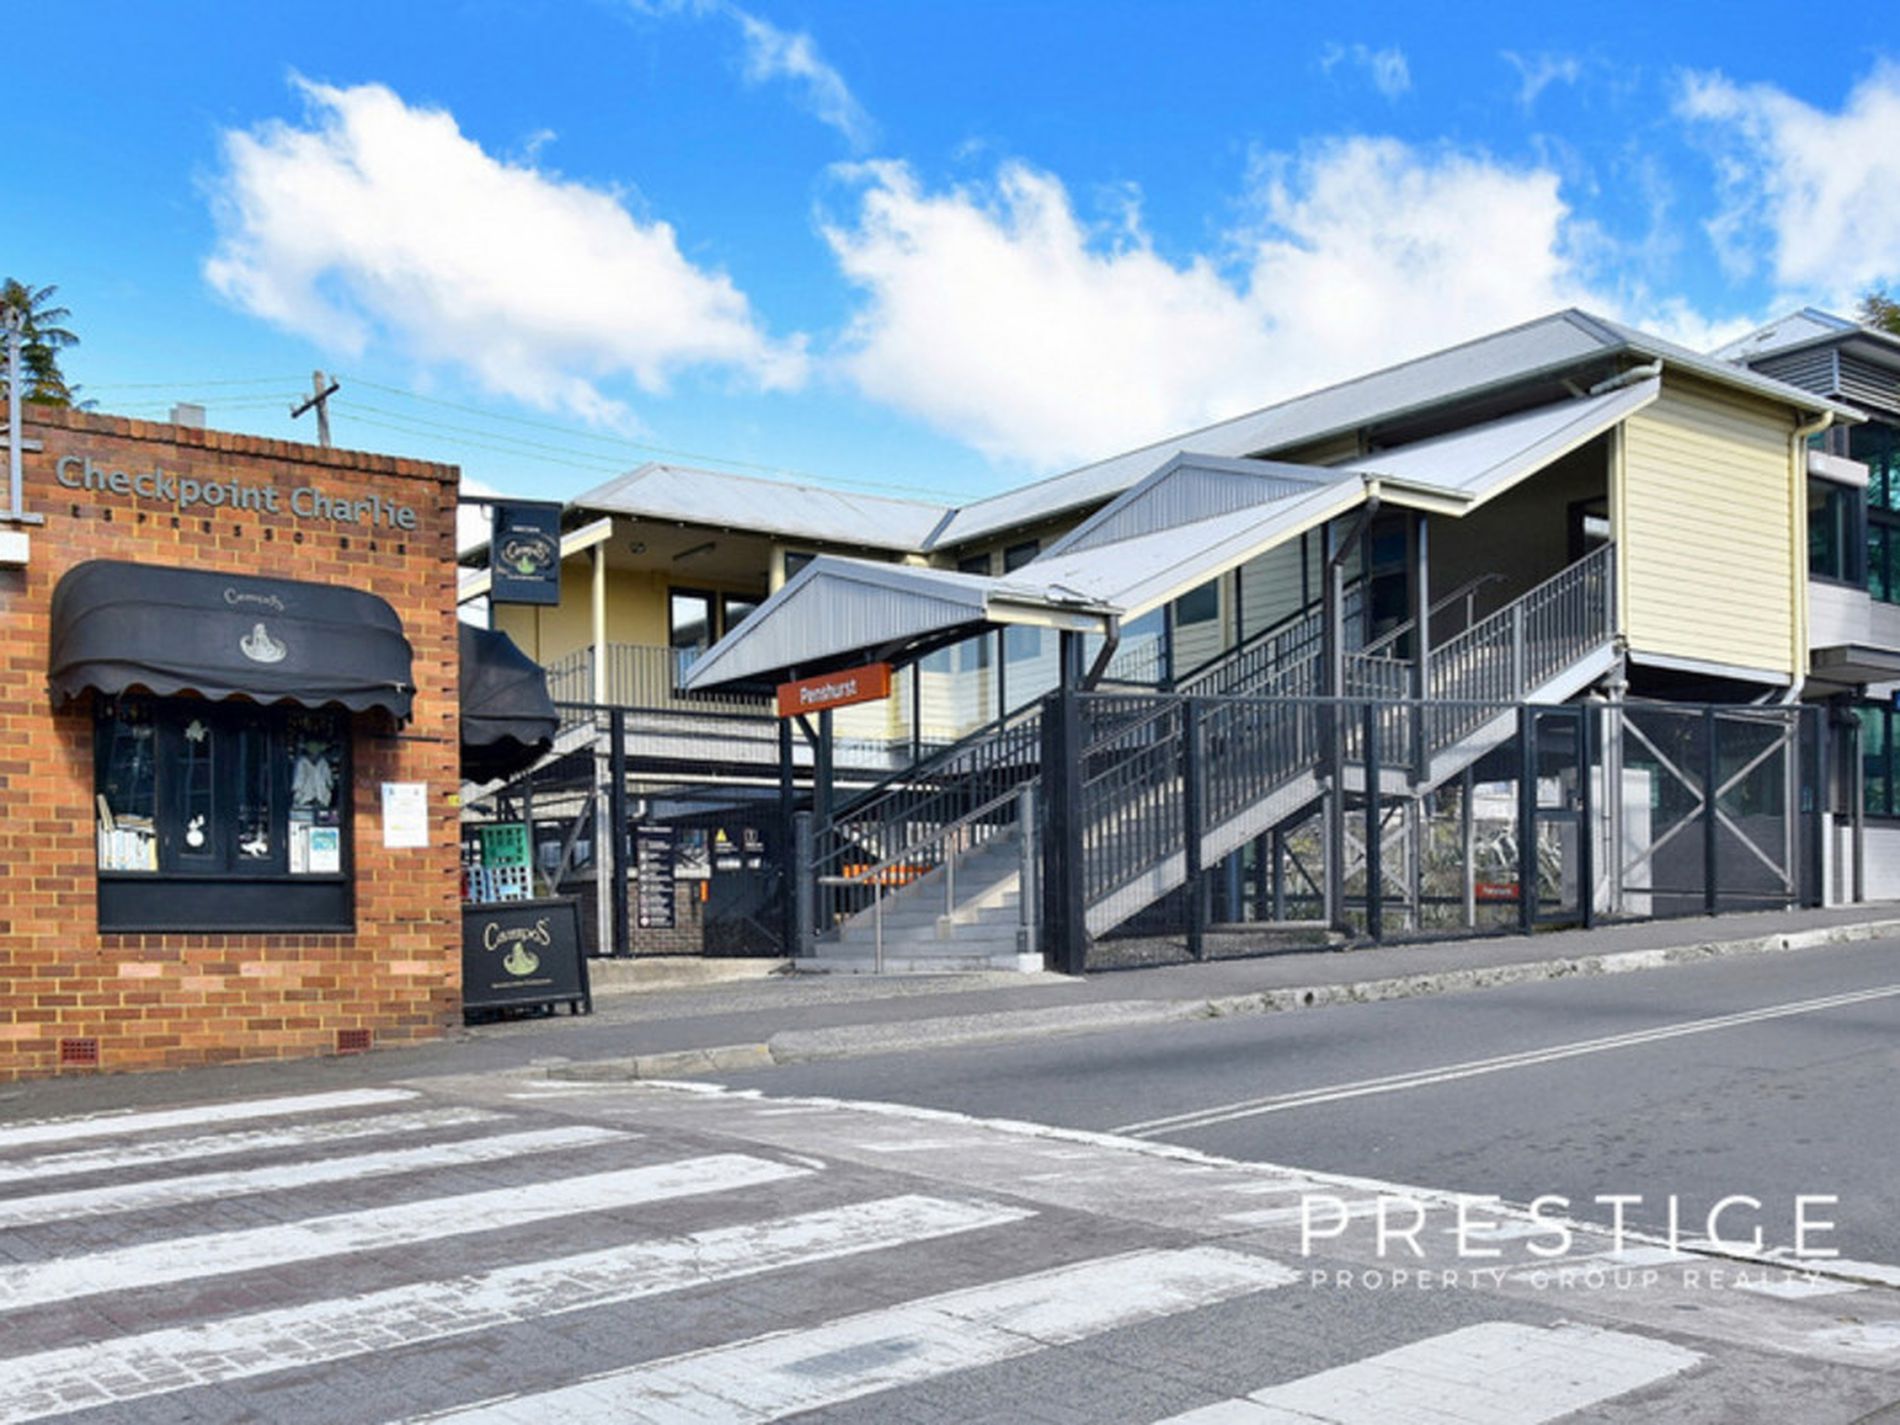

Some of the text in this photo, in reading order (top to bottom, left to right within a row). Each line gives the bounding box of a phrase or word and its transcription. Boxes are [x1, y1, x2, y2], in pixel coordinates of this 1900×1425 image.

[56, 455, 417, 530] Checkpoint Charlie
[71, 503, 406, 555] ESPRESSO BAR
[800, 679, 858, 705] Penshurst
